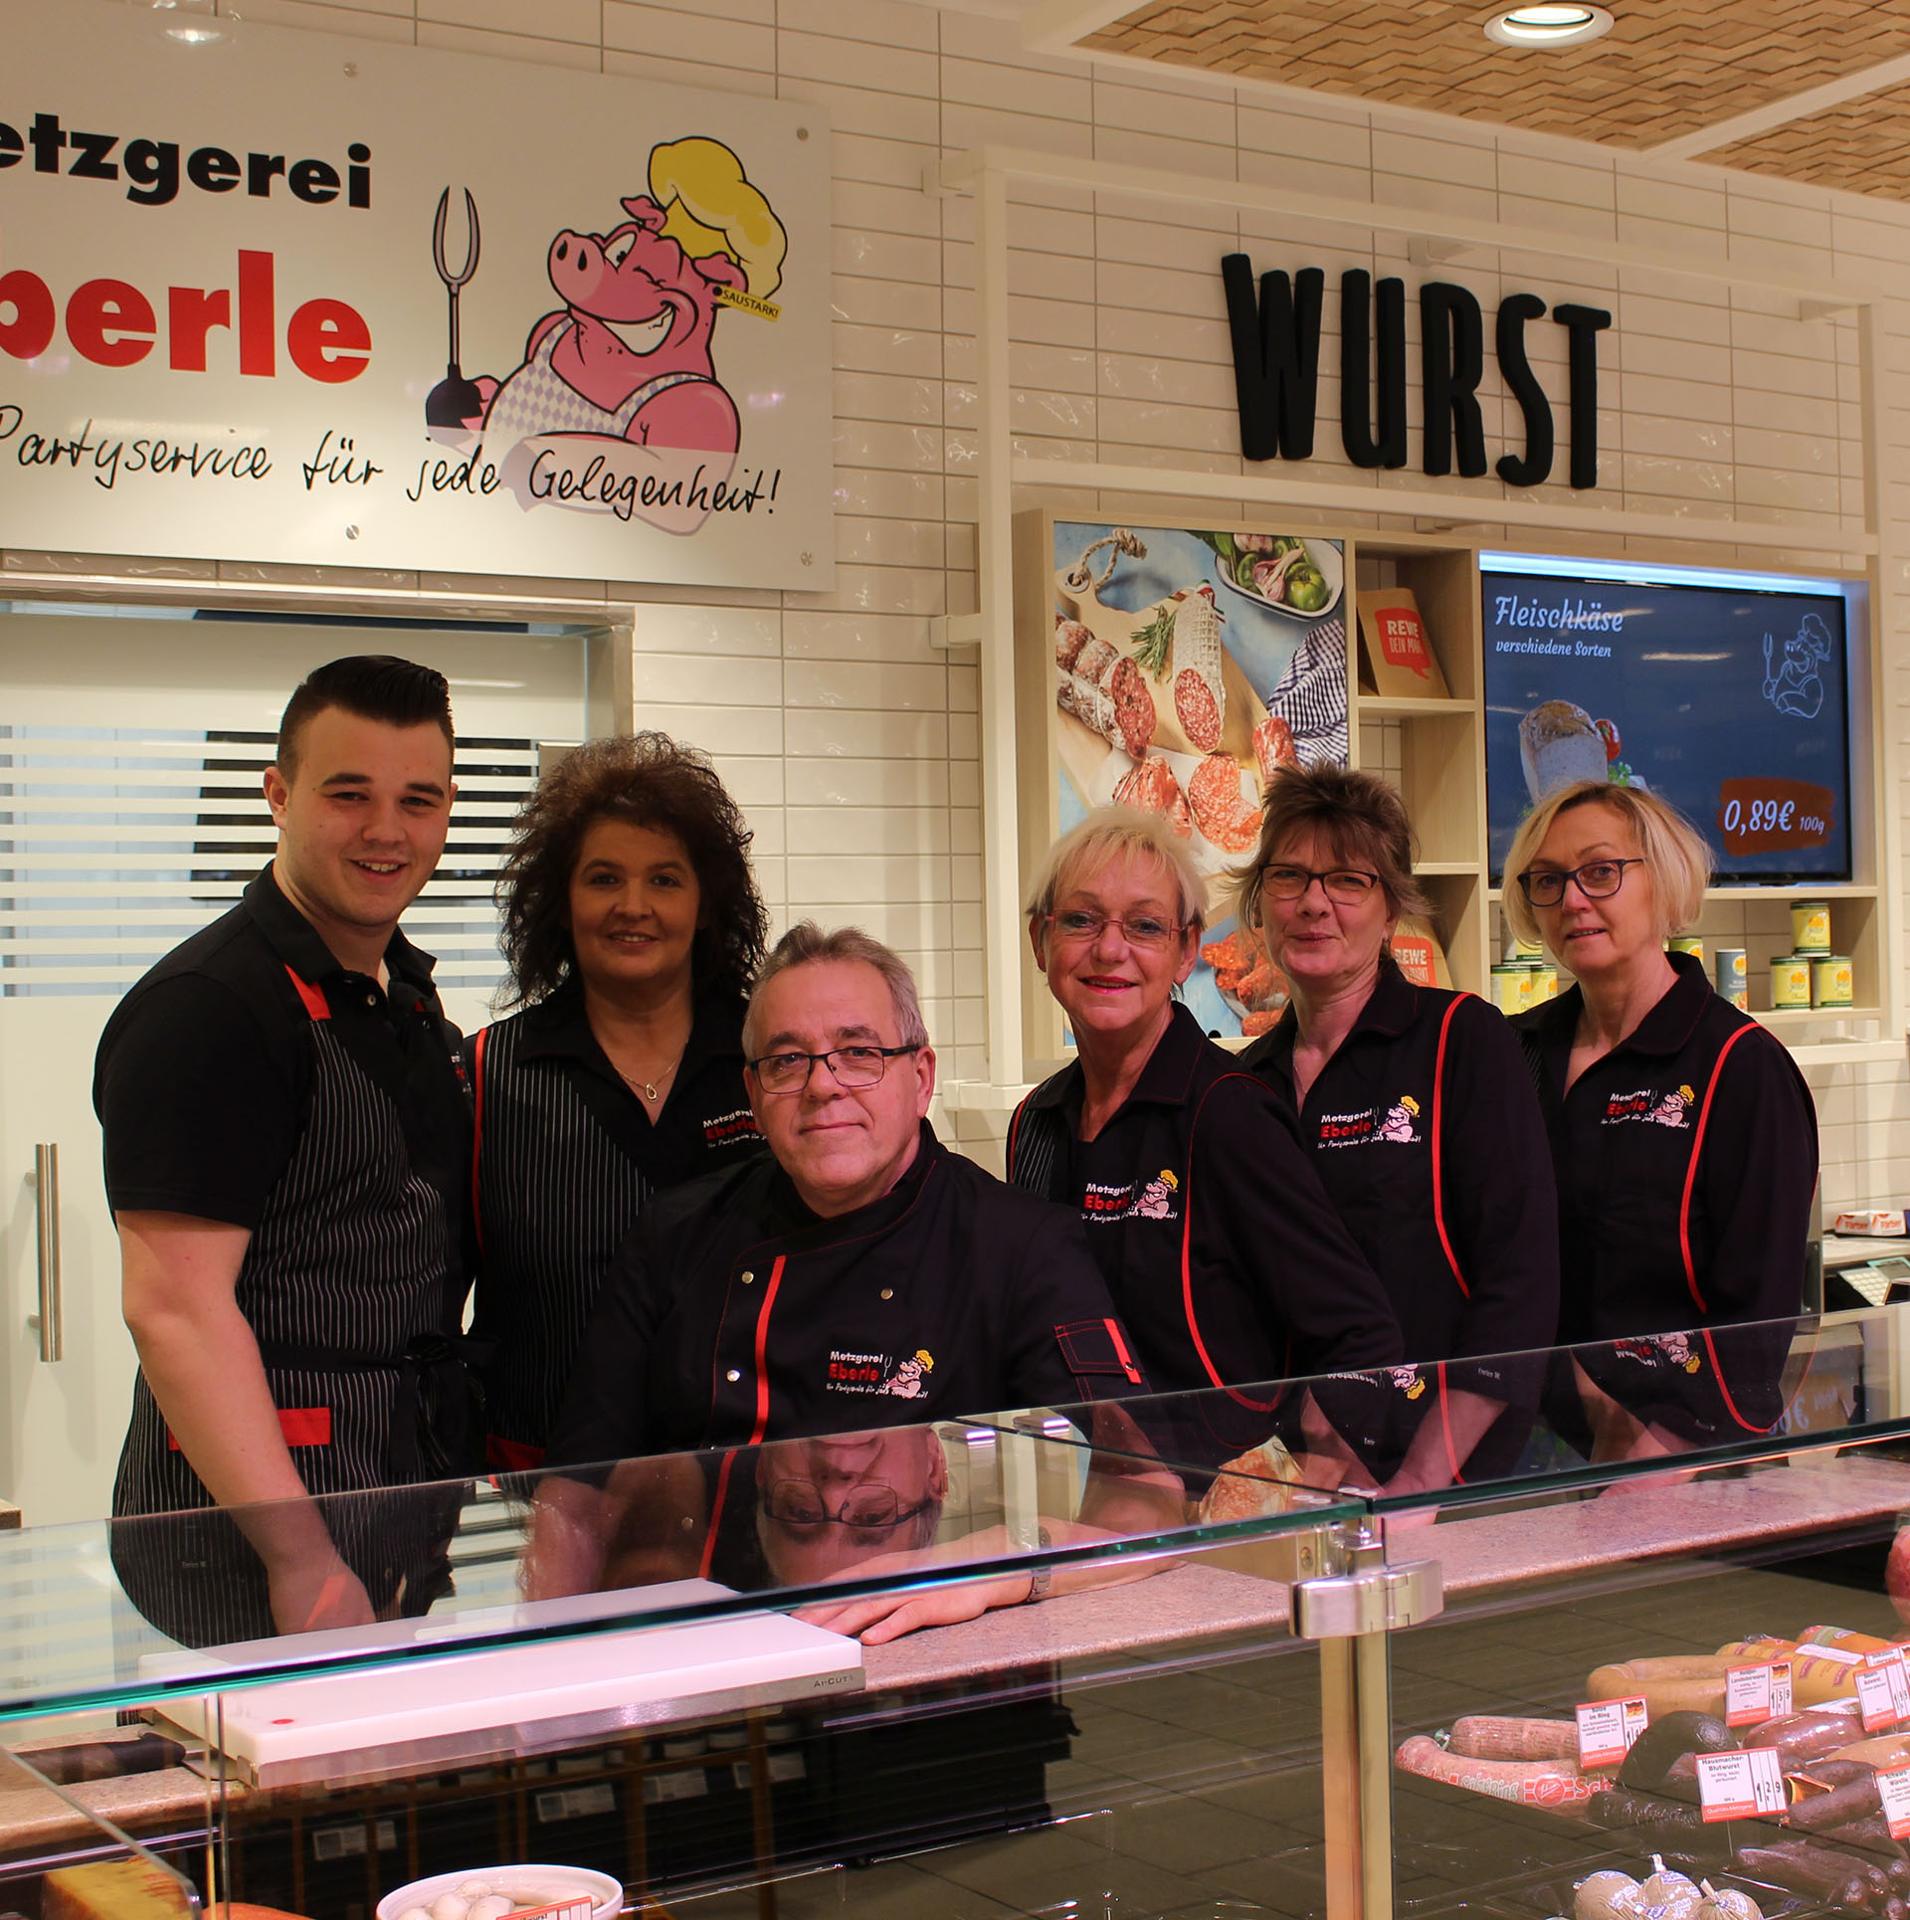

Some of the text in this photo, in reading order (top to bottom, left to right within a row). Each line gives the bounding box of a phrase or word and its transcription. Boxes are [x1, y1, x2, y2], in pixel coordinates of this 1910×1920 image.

[1221, 253, 1612, 490] WURST
[0, 405, 782, 521] Partyservice für jede Gelegenheit!
[1495, 595, 1624, 632] Fleischkäse
[1495, 637, 1612, 657] verschiedene Sorten
[1724, 799, 1825, 836] 0,89€ 100g
